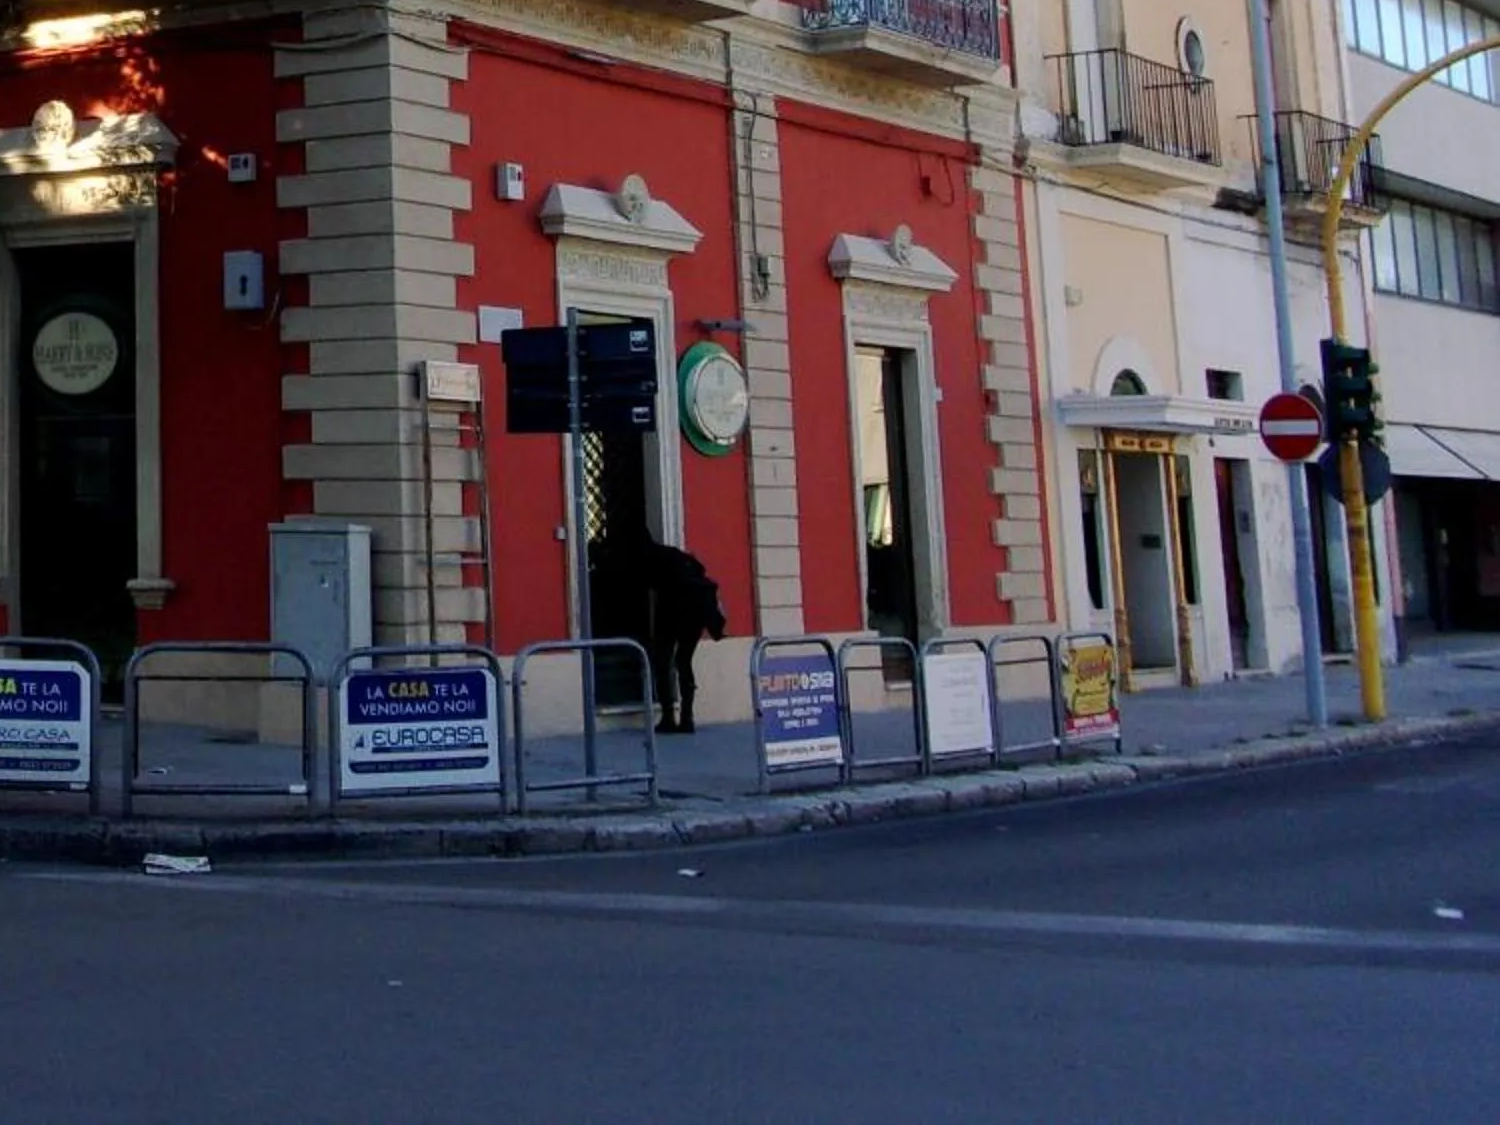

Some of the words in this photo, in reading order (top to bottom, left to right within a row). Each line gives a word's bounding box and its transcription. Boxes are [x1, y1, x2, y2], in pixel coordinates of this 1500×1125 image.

[21, 682, 37, 696] TE
[42, 682, 61, 696] LA
[366, 686, 384, 700] LA
[388, 681, 430, 698] CASA
[433, 684, 449, 697] TE
[452, 683, 469, 696] LA
[359, 701, 439, 716] VENDIAMO
[371, 726, 485, 746] EUROCASA
